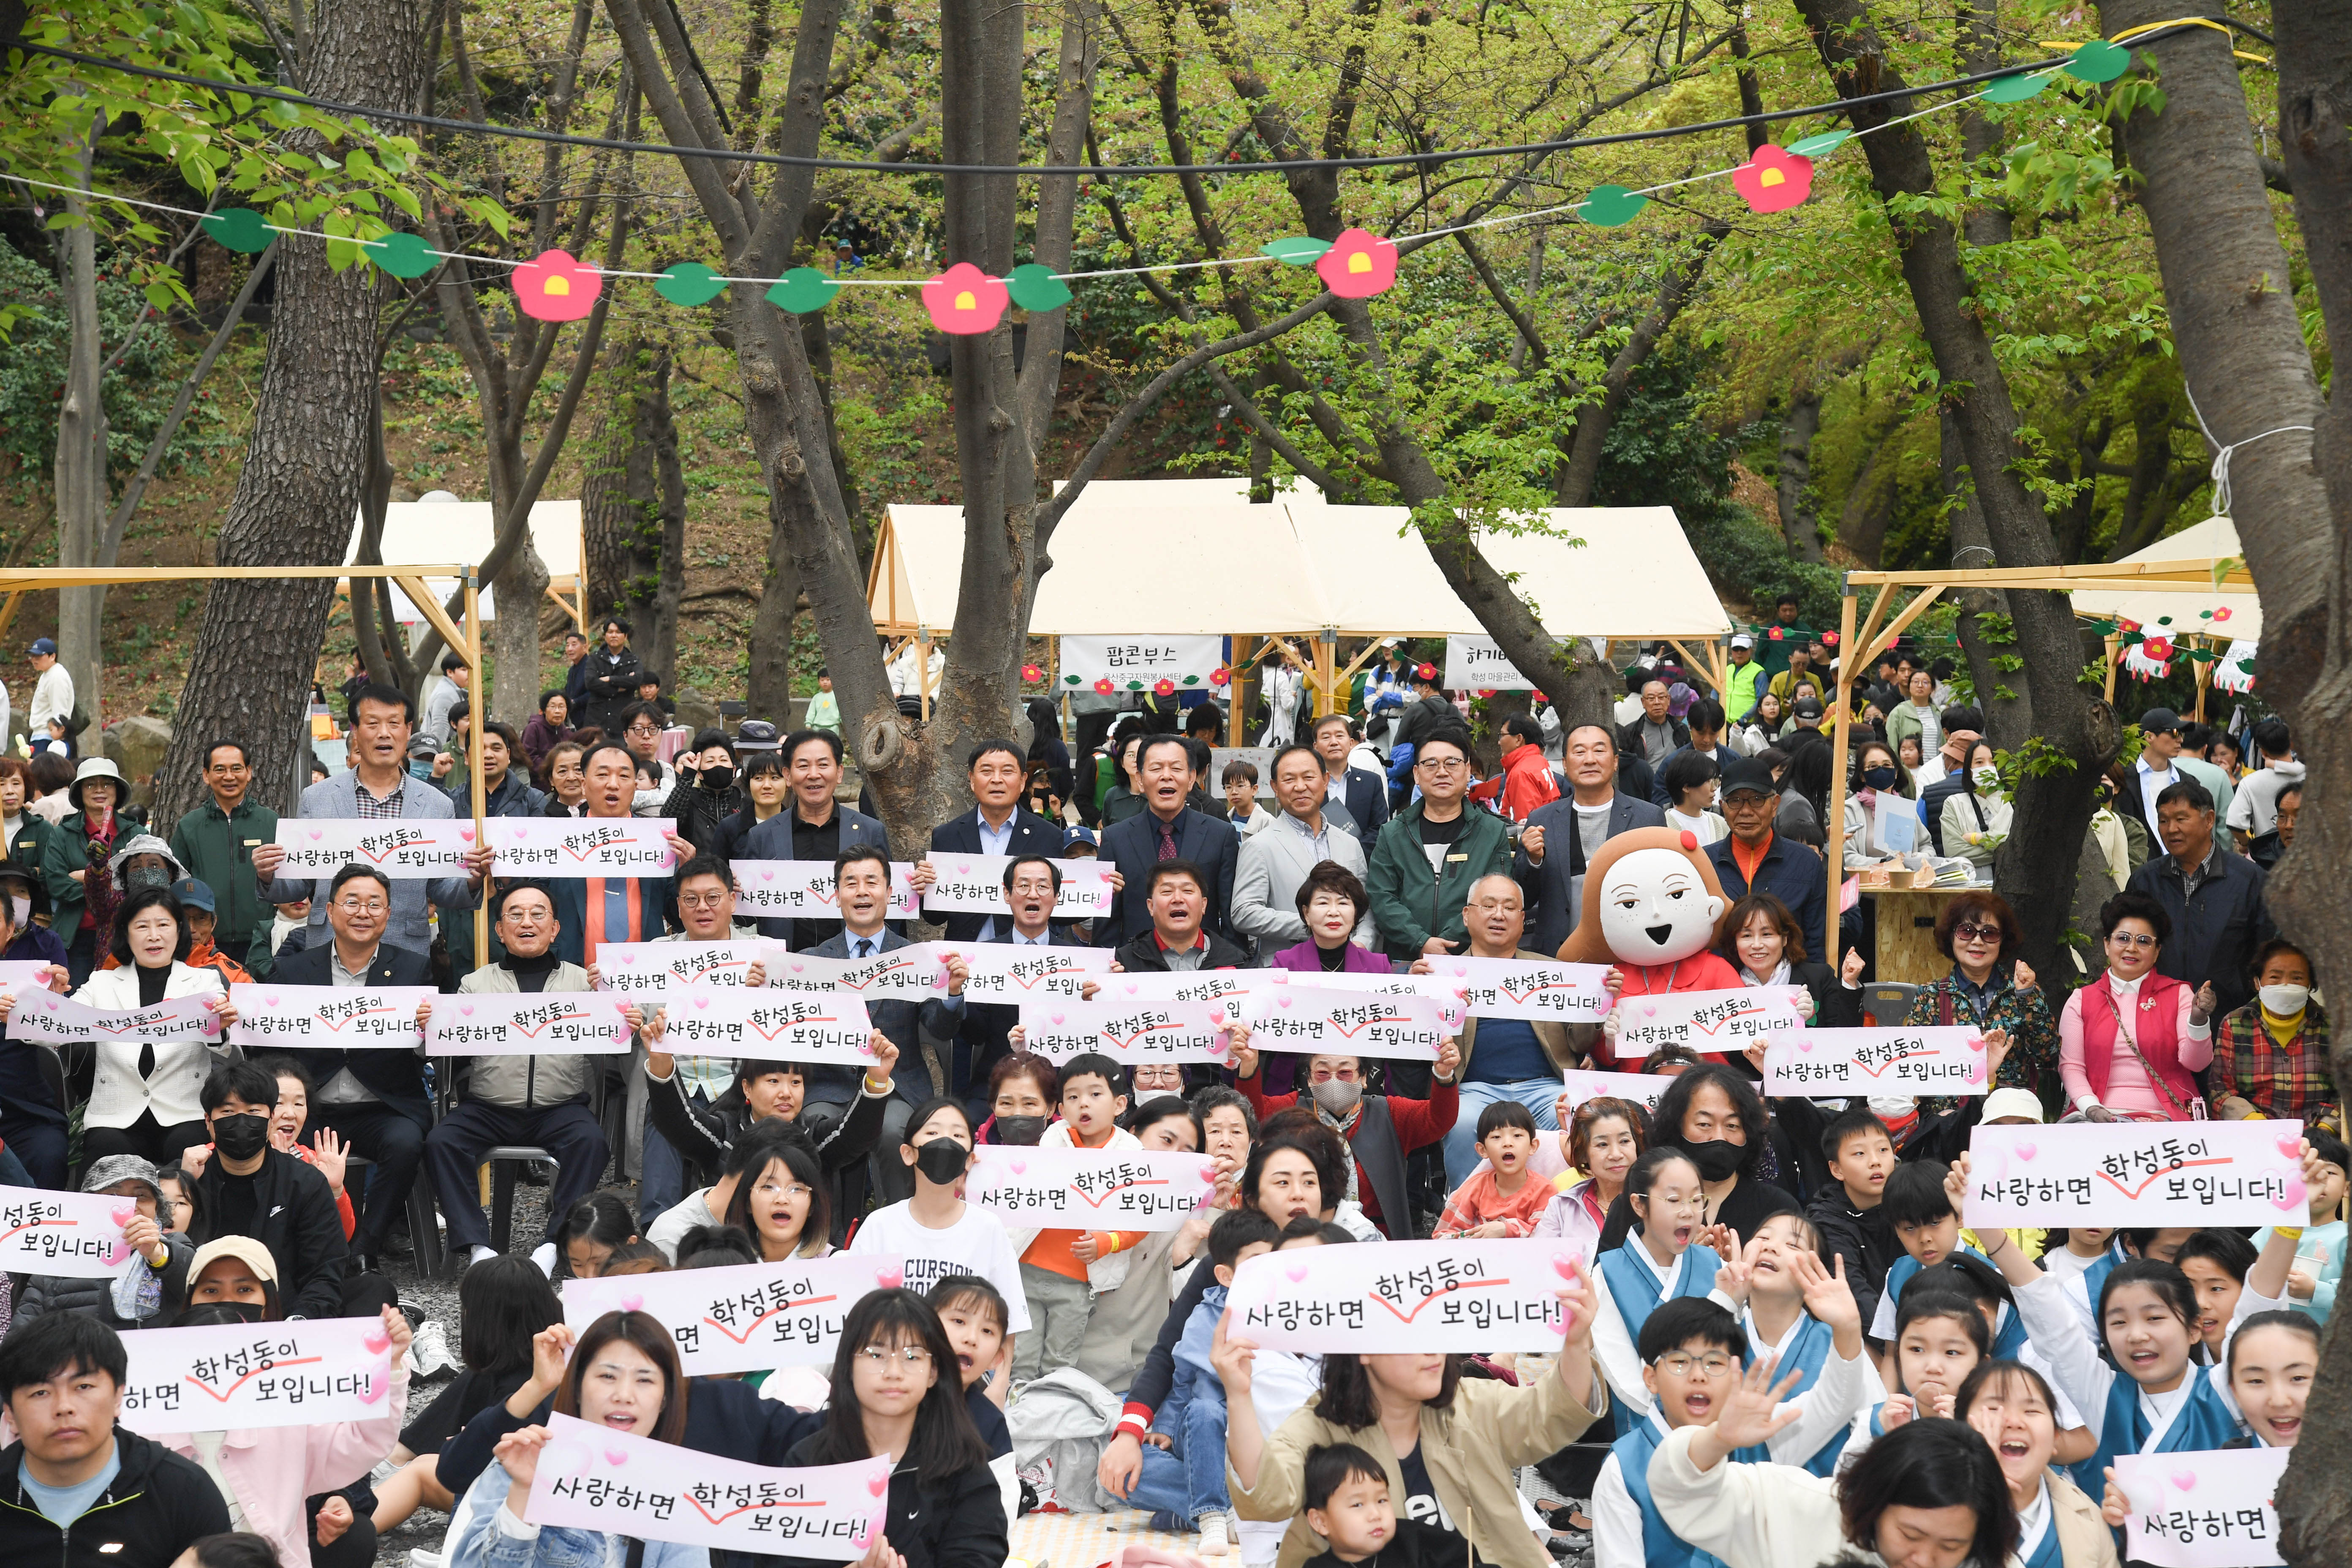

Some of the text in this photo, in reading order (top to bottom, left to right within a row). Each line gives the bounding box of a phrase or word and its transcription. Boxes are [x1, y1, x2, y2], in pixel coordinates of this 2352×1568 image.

[1107, 645, 1176, 667] 팝콘부스
[1103, 672, 1181, 683] 울산중구자원봉사센터
[1471, 672, 1486, 682] 학성
[1488, 672, 1518, 681] 마을관리
[361, 828, 422, 853] 학성동이
[564, 827, 624, 851] 학성동이
[1070, 829, 1080, 838] R
[287, 850, 464, 867] 사랑하면 보입니다!
[493, 848, 663, 865] 사랑하면 보입니다!
[741, 890, 803, 906] 사랑하면
[936, 883, 1100, 905] 사랑하면 입니다!
[672, 950, 732, 976] 학성동이
[841, 956, 901, 983] 학성동이
[1012, 956, 1072, 979] 학성동이
[602, 973, 666, 991] 사랑하면
[877, 972, 939, 988] 보입니다!
[1503, 971, 1563, 993] 학성동이
[318, 996, 384, 1022] 학성동이
[1331, 1003, 1397, 1026] 학성동이
[1537, 994, 1601, 1010] 보입니다!
[1693, 998, 1752, 1025] 학성동이
[20, 1014, 209, 1037] 사랑하면 보입니다!
[96, 1010, 163, 1028] 학성동이
[242, 1016, 310, 1034] 사랑하면
[513, 1002, 576, 1029] 학성동이
[751, 1002, 822, 1028] 학성동이
[1105, 1011, 1169, 1038] 학성동이
[438, 1024, 618, 1043] 사랑하면 보입니다!
[666, 1020, 867, 1048] 사랑하면 보입니다!
[1252, 1018, 1440, 1045] 사랑하면 보입니다!
[1626, 1024, 1688, 1044] 사랑하면
[1029, 1035, 1214, 1054] 사랑하면 보입니다!
[1855, 1038, 1924, 1066] 학성동이
[1776, 1062, 1972, 1082] 사랑하면 보입니다!
[2102, 1139, 2208, 1181] 학성동이
[1075, 1163, 1152, 1194] 학성동이
[1981, 1176, 2283, 1206] 사랑하면 보입니다!
[982, 1187, 1065, 1210] 사랑하면
[0, 1201, 61, 1228] 성동이
[20, 1233, 111, 1258] 보입니다!
[1376, 1258, 1484, 1304] 학성동이
[710, 1278, 813, 1326] 학성동이
[1247, 1299, 1560, 1331] 사랑하면 보입니다!
[192, 1339, 298, 1385] 학성동이
[256, 1374, 369, 1403] 보입니다!
[693, 1482, 803, 1508] 학성동이
[553, 1478, 866, 1539] 사랑하면 보입니다!
[2145, 1508, 2266, 1543] 사랑하면
